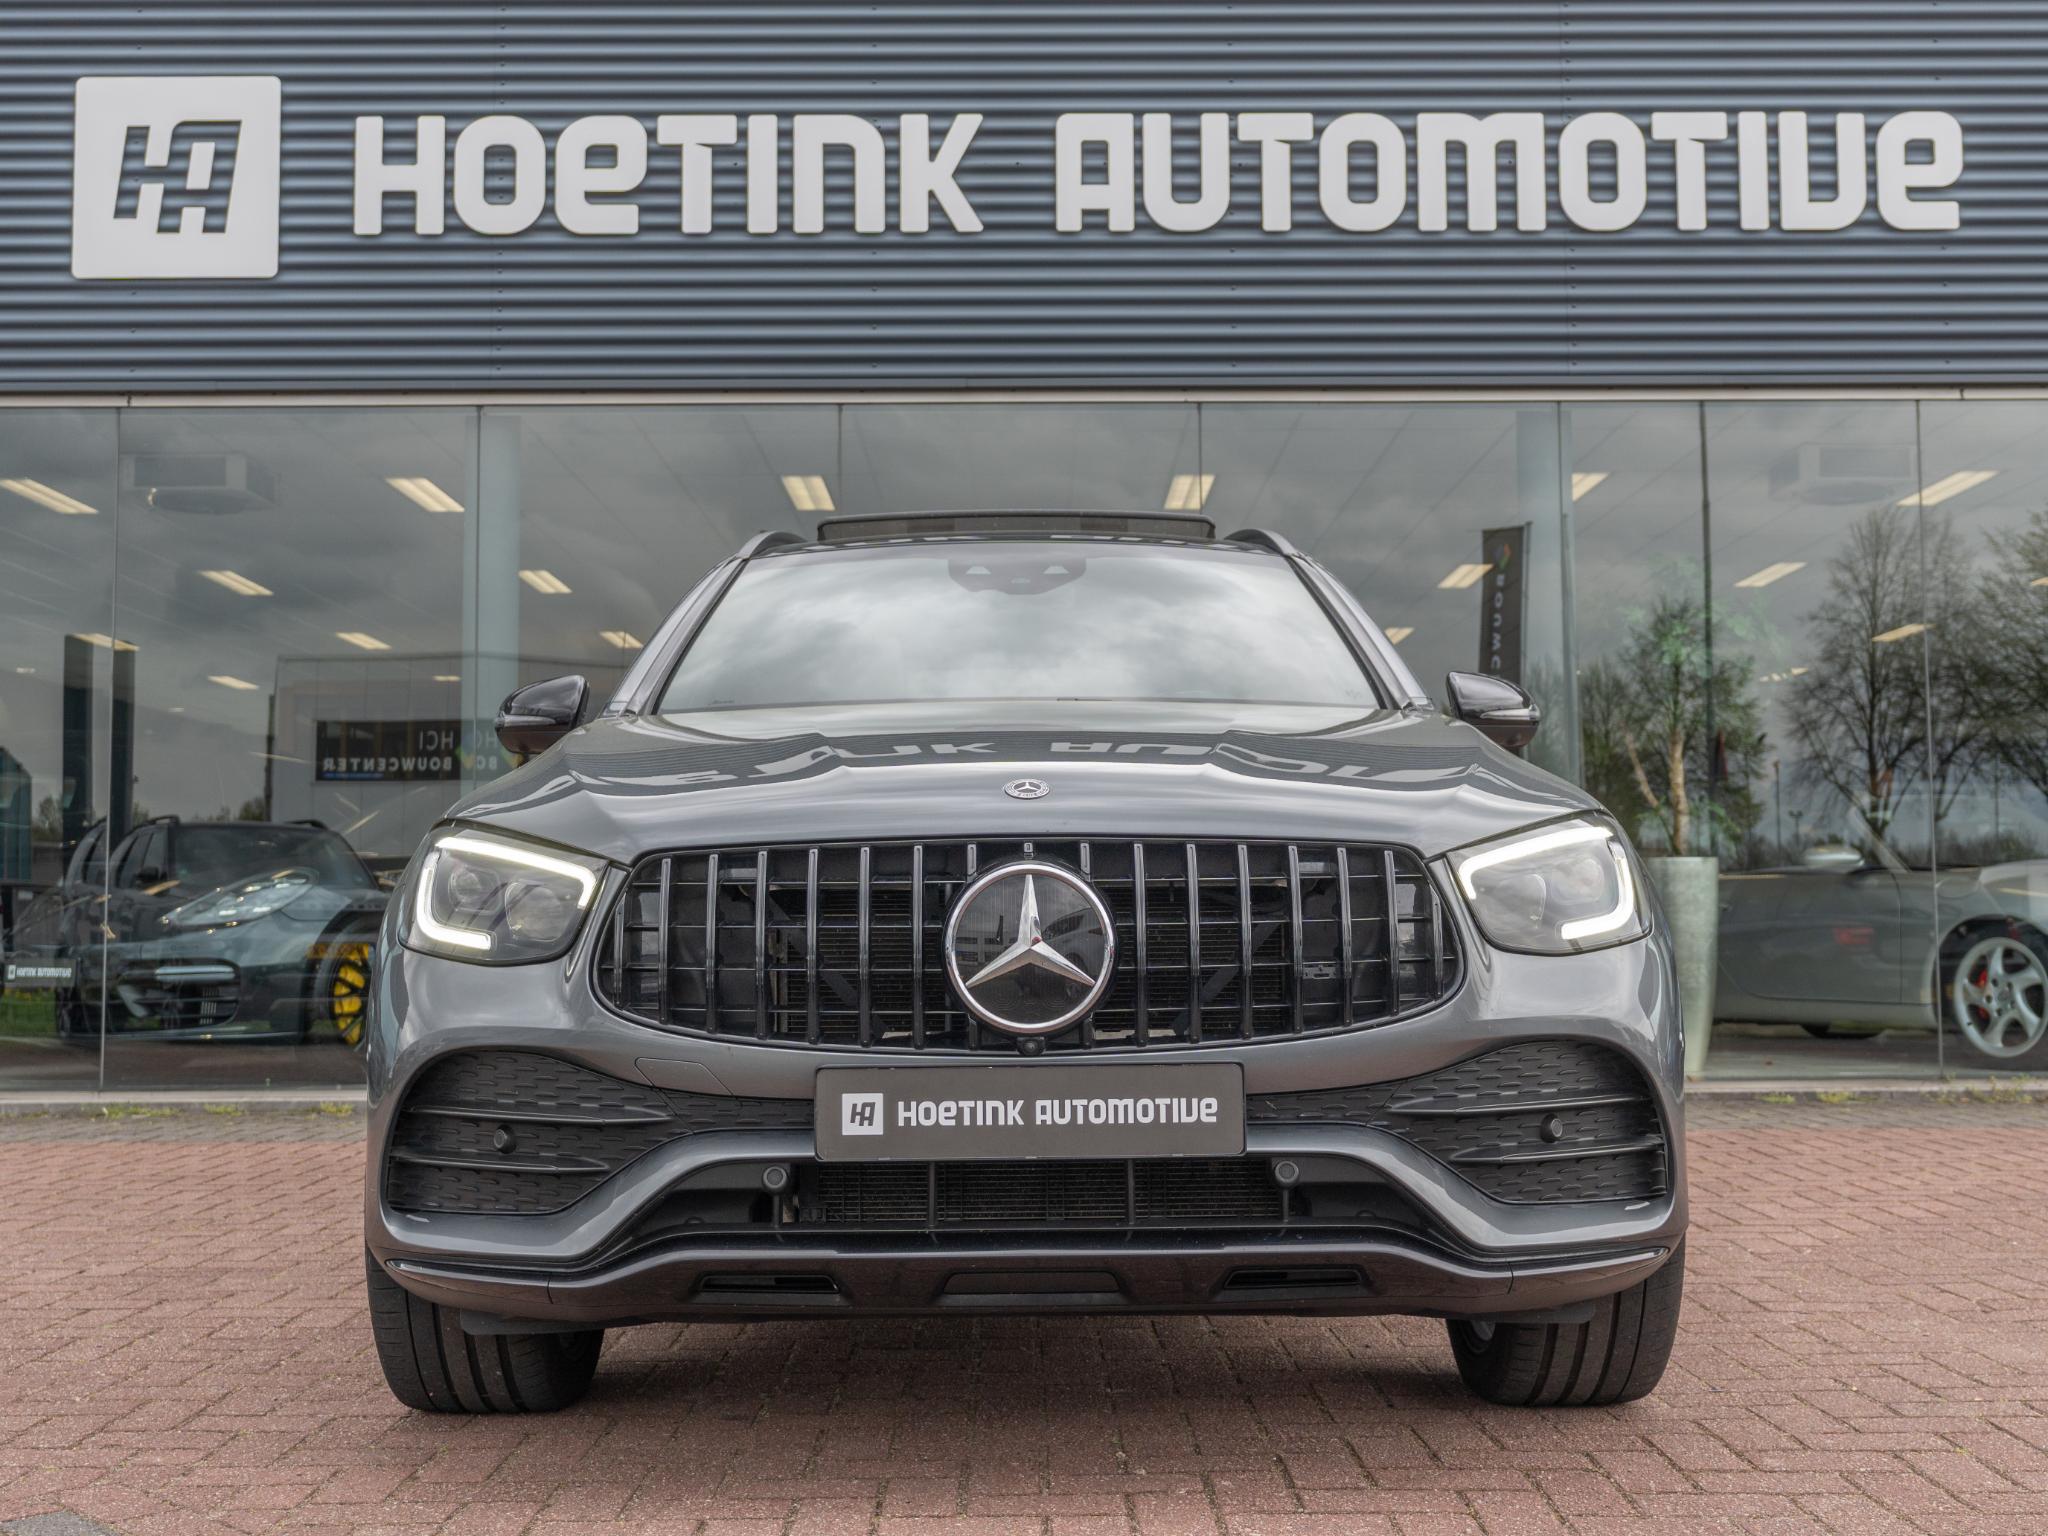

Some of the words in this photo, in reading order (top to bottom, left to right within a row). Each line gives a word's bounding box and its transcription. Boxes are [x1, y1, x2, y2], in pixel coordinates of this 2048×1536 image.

[353, 113, 984, 235] HOETINK
[1055, 110, 1964, 232] AUTOMOTIVE
[898, 1100, 1024, 1126] HOETINK
[1035, 1098, 1217, 1124] AUTOMOTIVE
